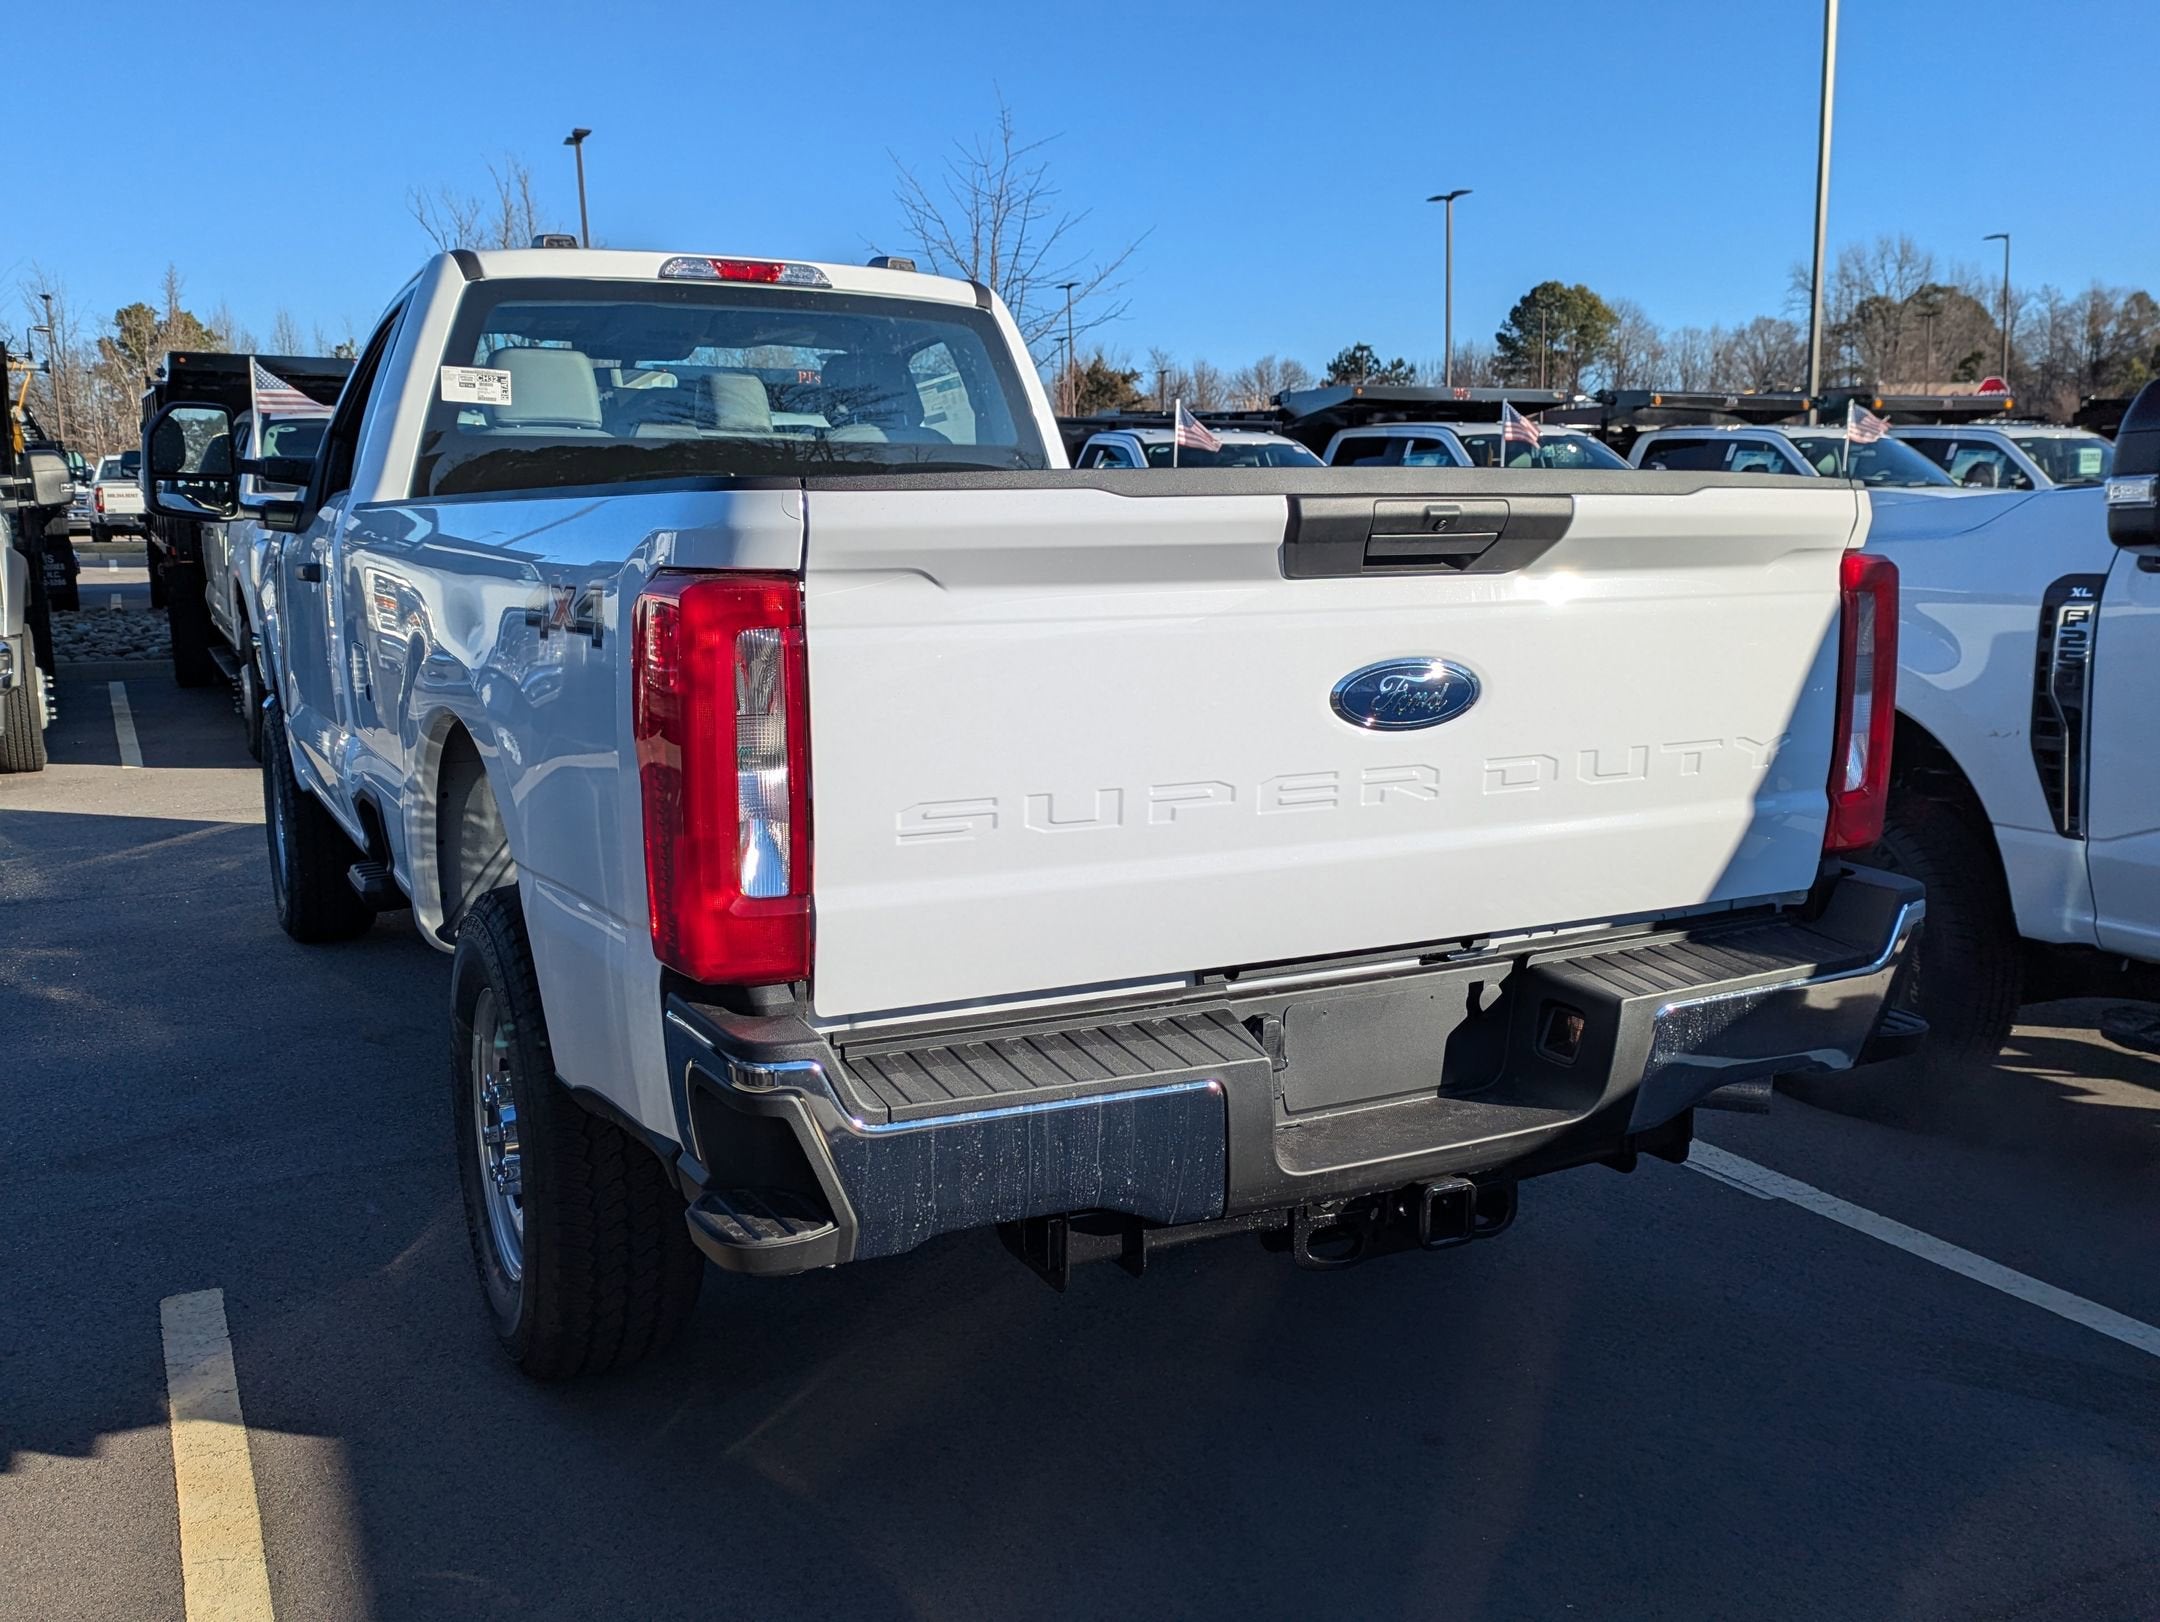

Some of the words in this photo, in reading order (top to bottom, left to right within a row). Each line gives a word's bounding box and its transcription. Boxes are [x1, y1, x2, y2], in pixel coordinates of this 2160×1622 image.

[2070, 586, 2093, 598] XL
[896, 763, 1440, 846] SUPER
[1482, 732, 1792, 796] DUTY
